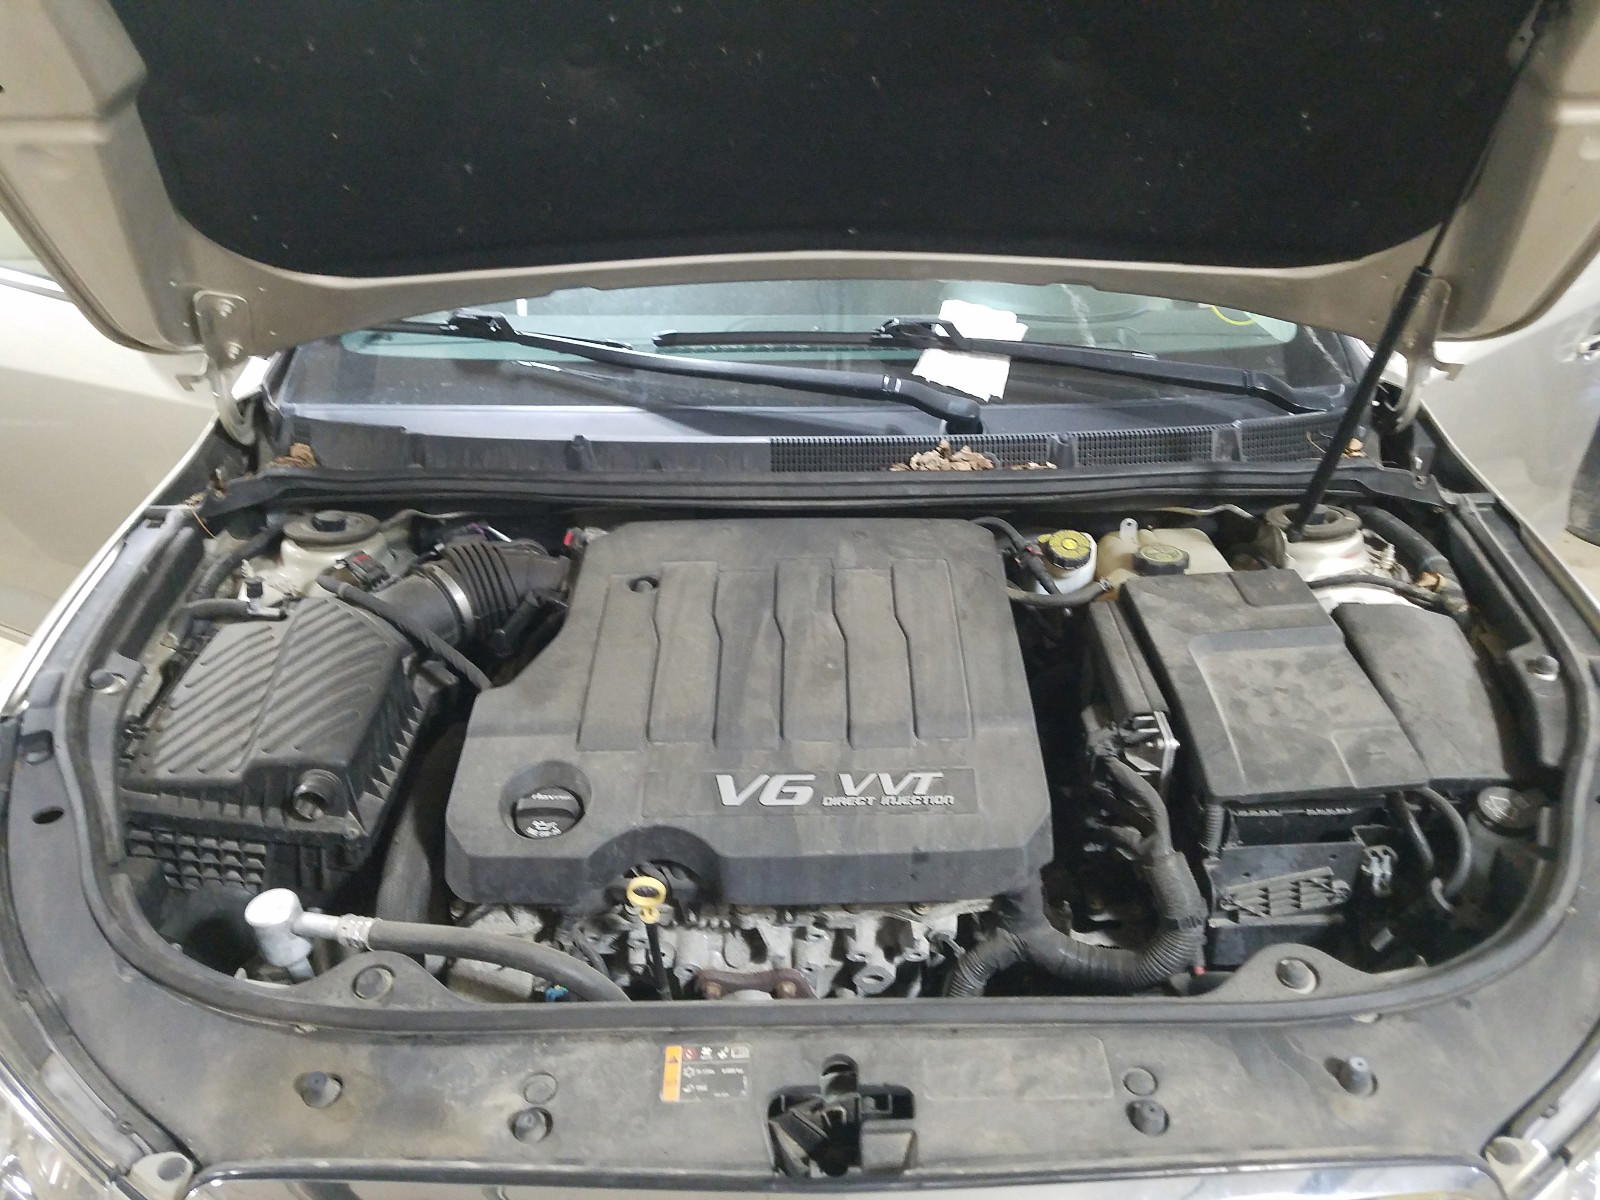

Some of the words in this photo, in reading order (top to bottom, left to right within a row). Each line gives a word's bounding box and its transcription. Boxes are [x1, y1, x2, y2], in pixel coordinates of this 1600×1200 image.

[716, 774, 816, 806] V6
[839, 773, 944, 796] VVT
[822, 796, 876, 807] DIRECT
[880, 795, 955, 807] INJECTION
